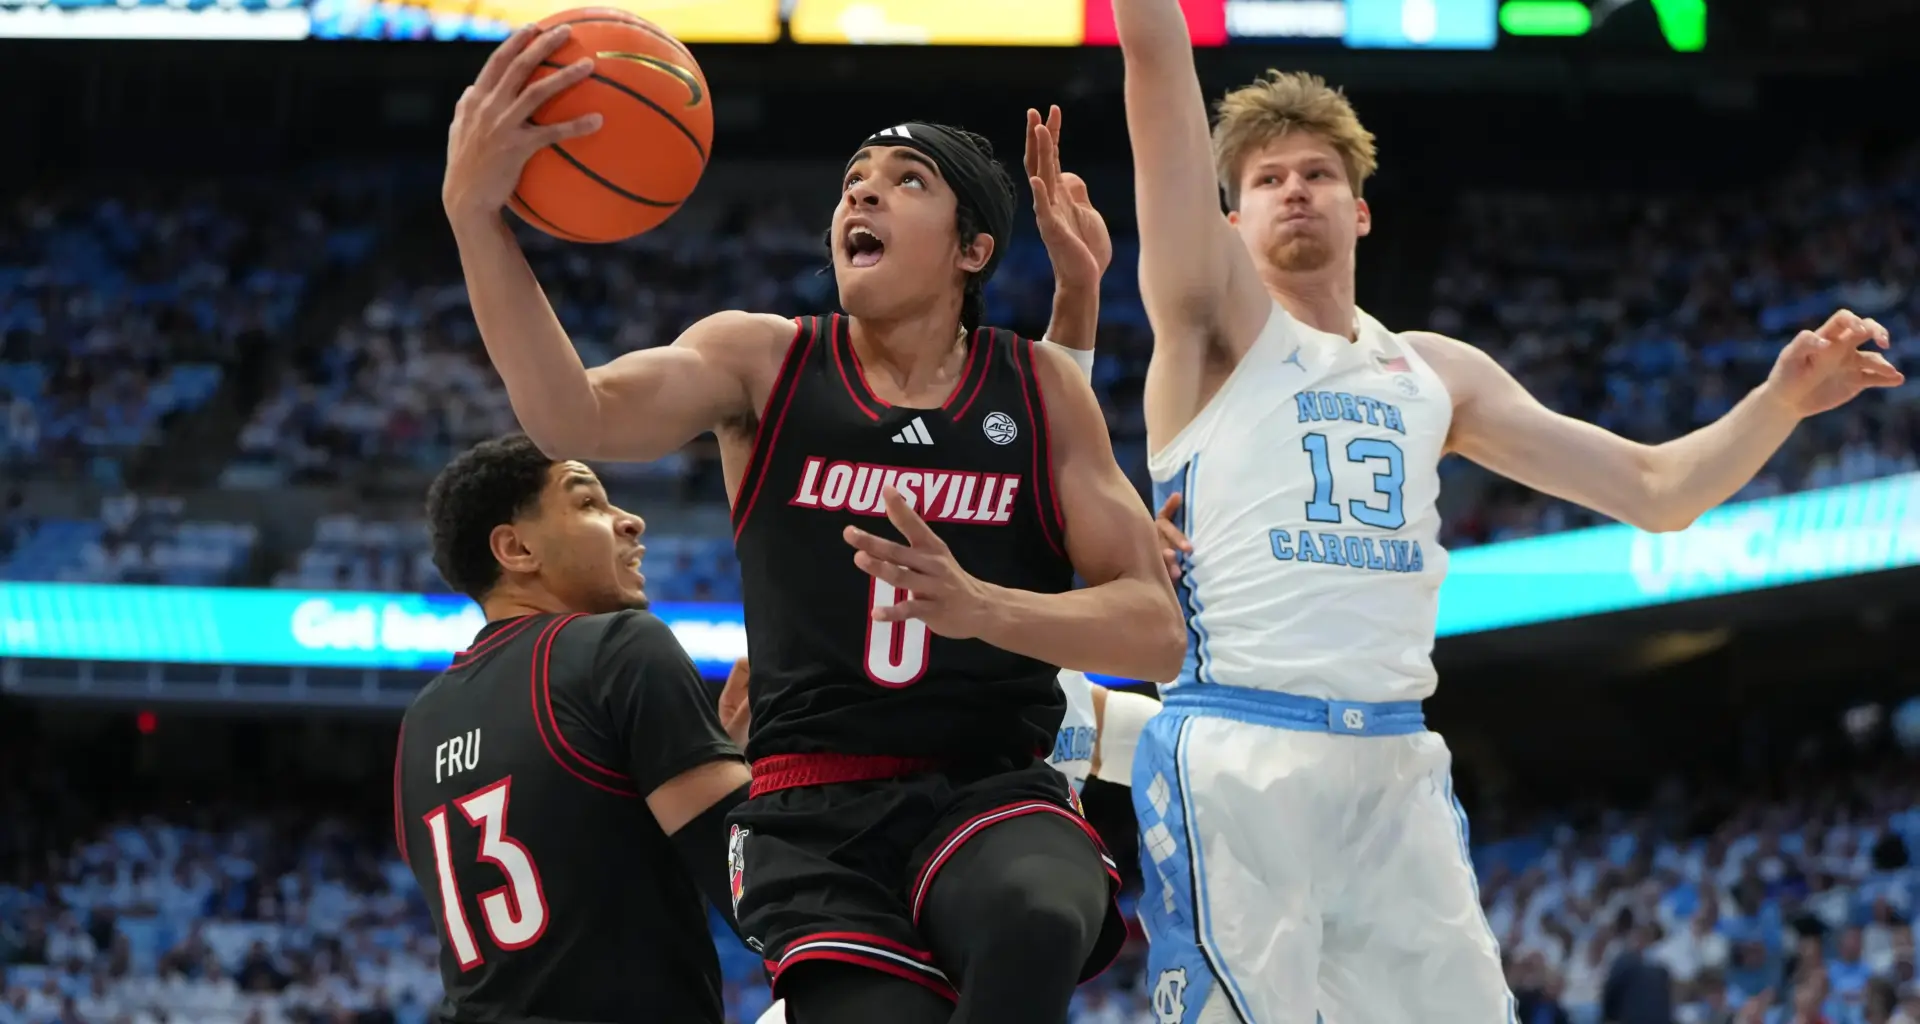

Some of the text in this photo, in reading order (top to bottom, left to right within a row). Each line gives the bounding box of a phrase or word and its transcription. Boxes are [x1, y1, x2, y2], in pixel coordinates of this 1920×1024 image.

[988, 422, 1014, 433] ACC
[1294, 391, 1406, 435] NORTH
[789, 456, 1021, 525] LOUISVILLE
[1302, 432, 1406, 530] 13
[1269, 529, 1424, 573] CAROLINA
[435, 728, 481, 784] FRU
[422, 774, 549, 973] 13
